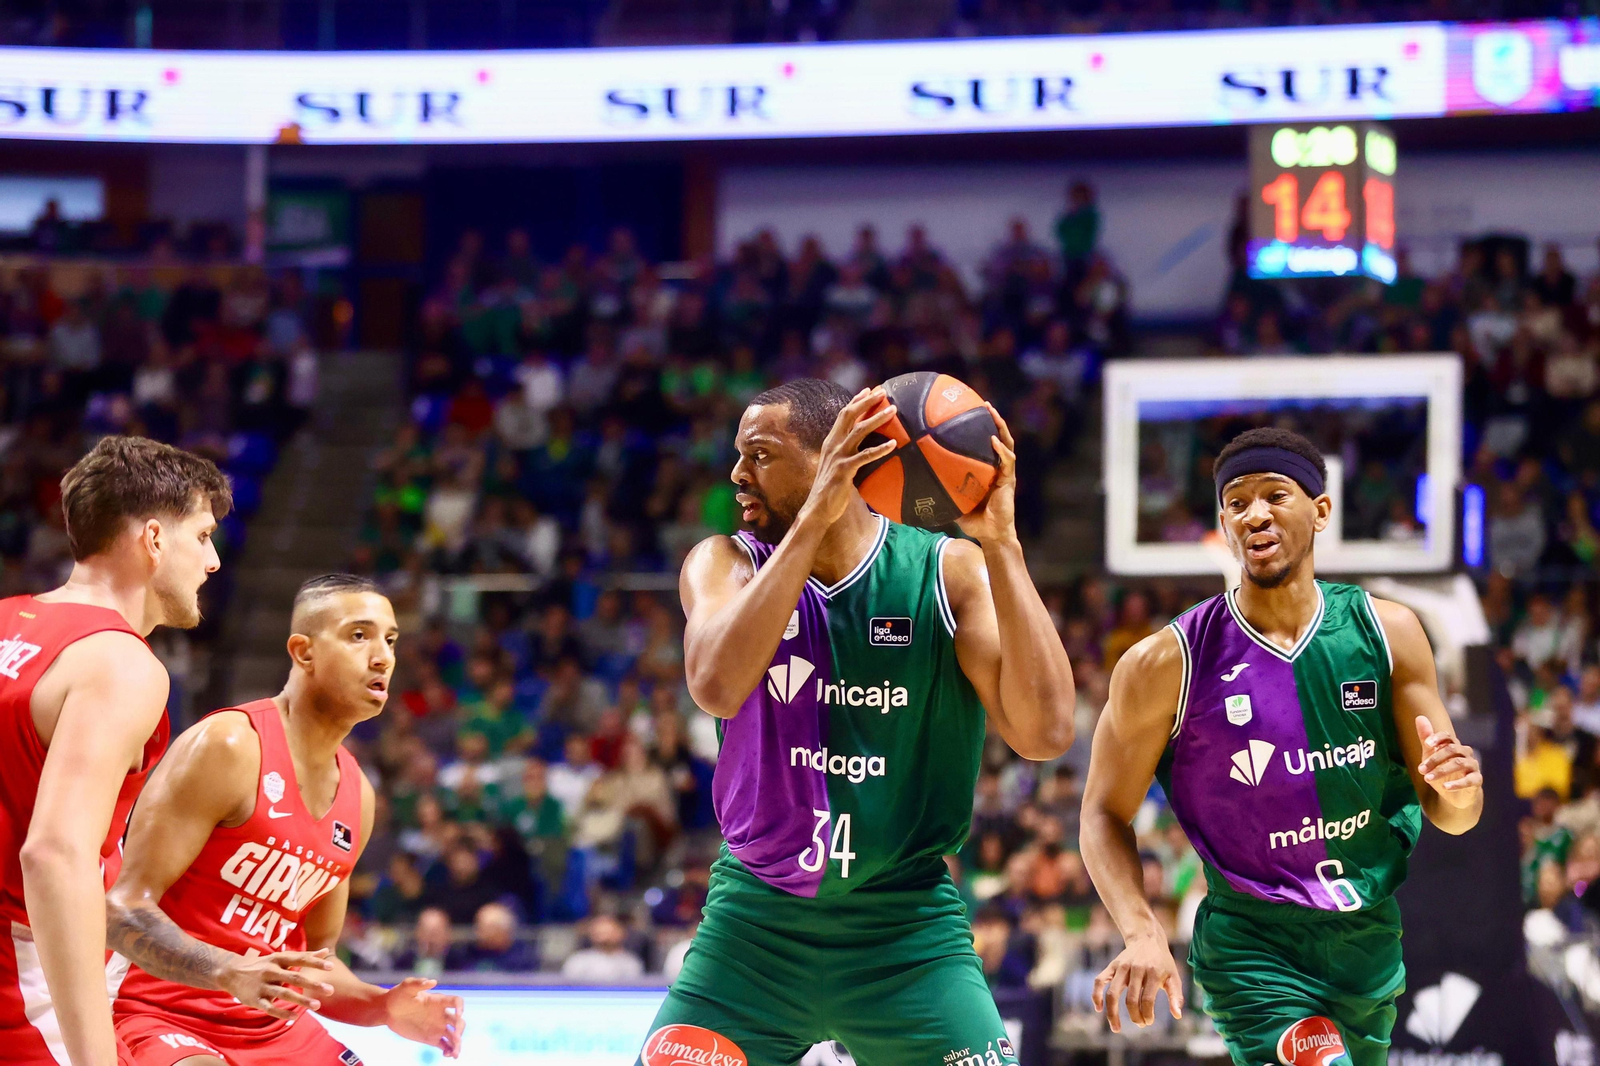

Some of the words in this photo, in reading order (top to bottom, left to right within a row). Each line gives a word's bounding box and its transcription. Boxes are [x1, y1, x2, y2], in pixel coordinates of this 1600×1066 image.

[604, 84, 771, 122] SUR
[910, 76, 1079, 114] SUR
[1221, 65, 1393, 103] SUR
[294, 89, 466, 126] SUR
[1262, 171, 1352, 243] 14
[874, 626, 890, 635] liga
[874, 634, 909, 642] endesa
[816, 678, 909, 715] nicaja
[1345, 691, 1358, 700] liga
[1345, 698, 1374, 706] endesa
[1283, 735, 1376, 775] Unicaja
[798, 807, 856, 879] 34
[1269, 808, 1371, 850] málaga
[1315, 858, 1363, 912] 6
[647, 1027, 744, 1066] famadesa
[943, 1047, 970, 1063] sabor
